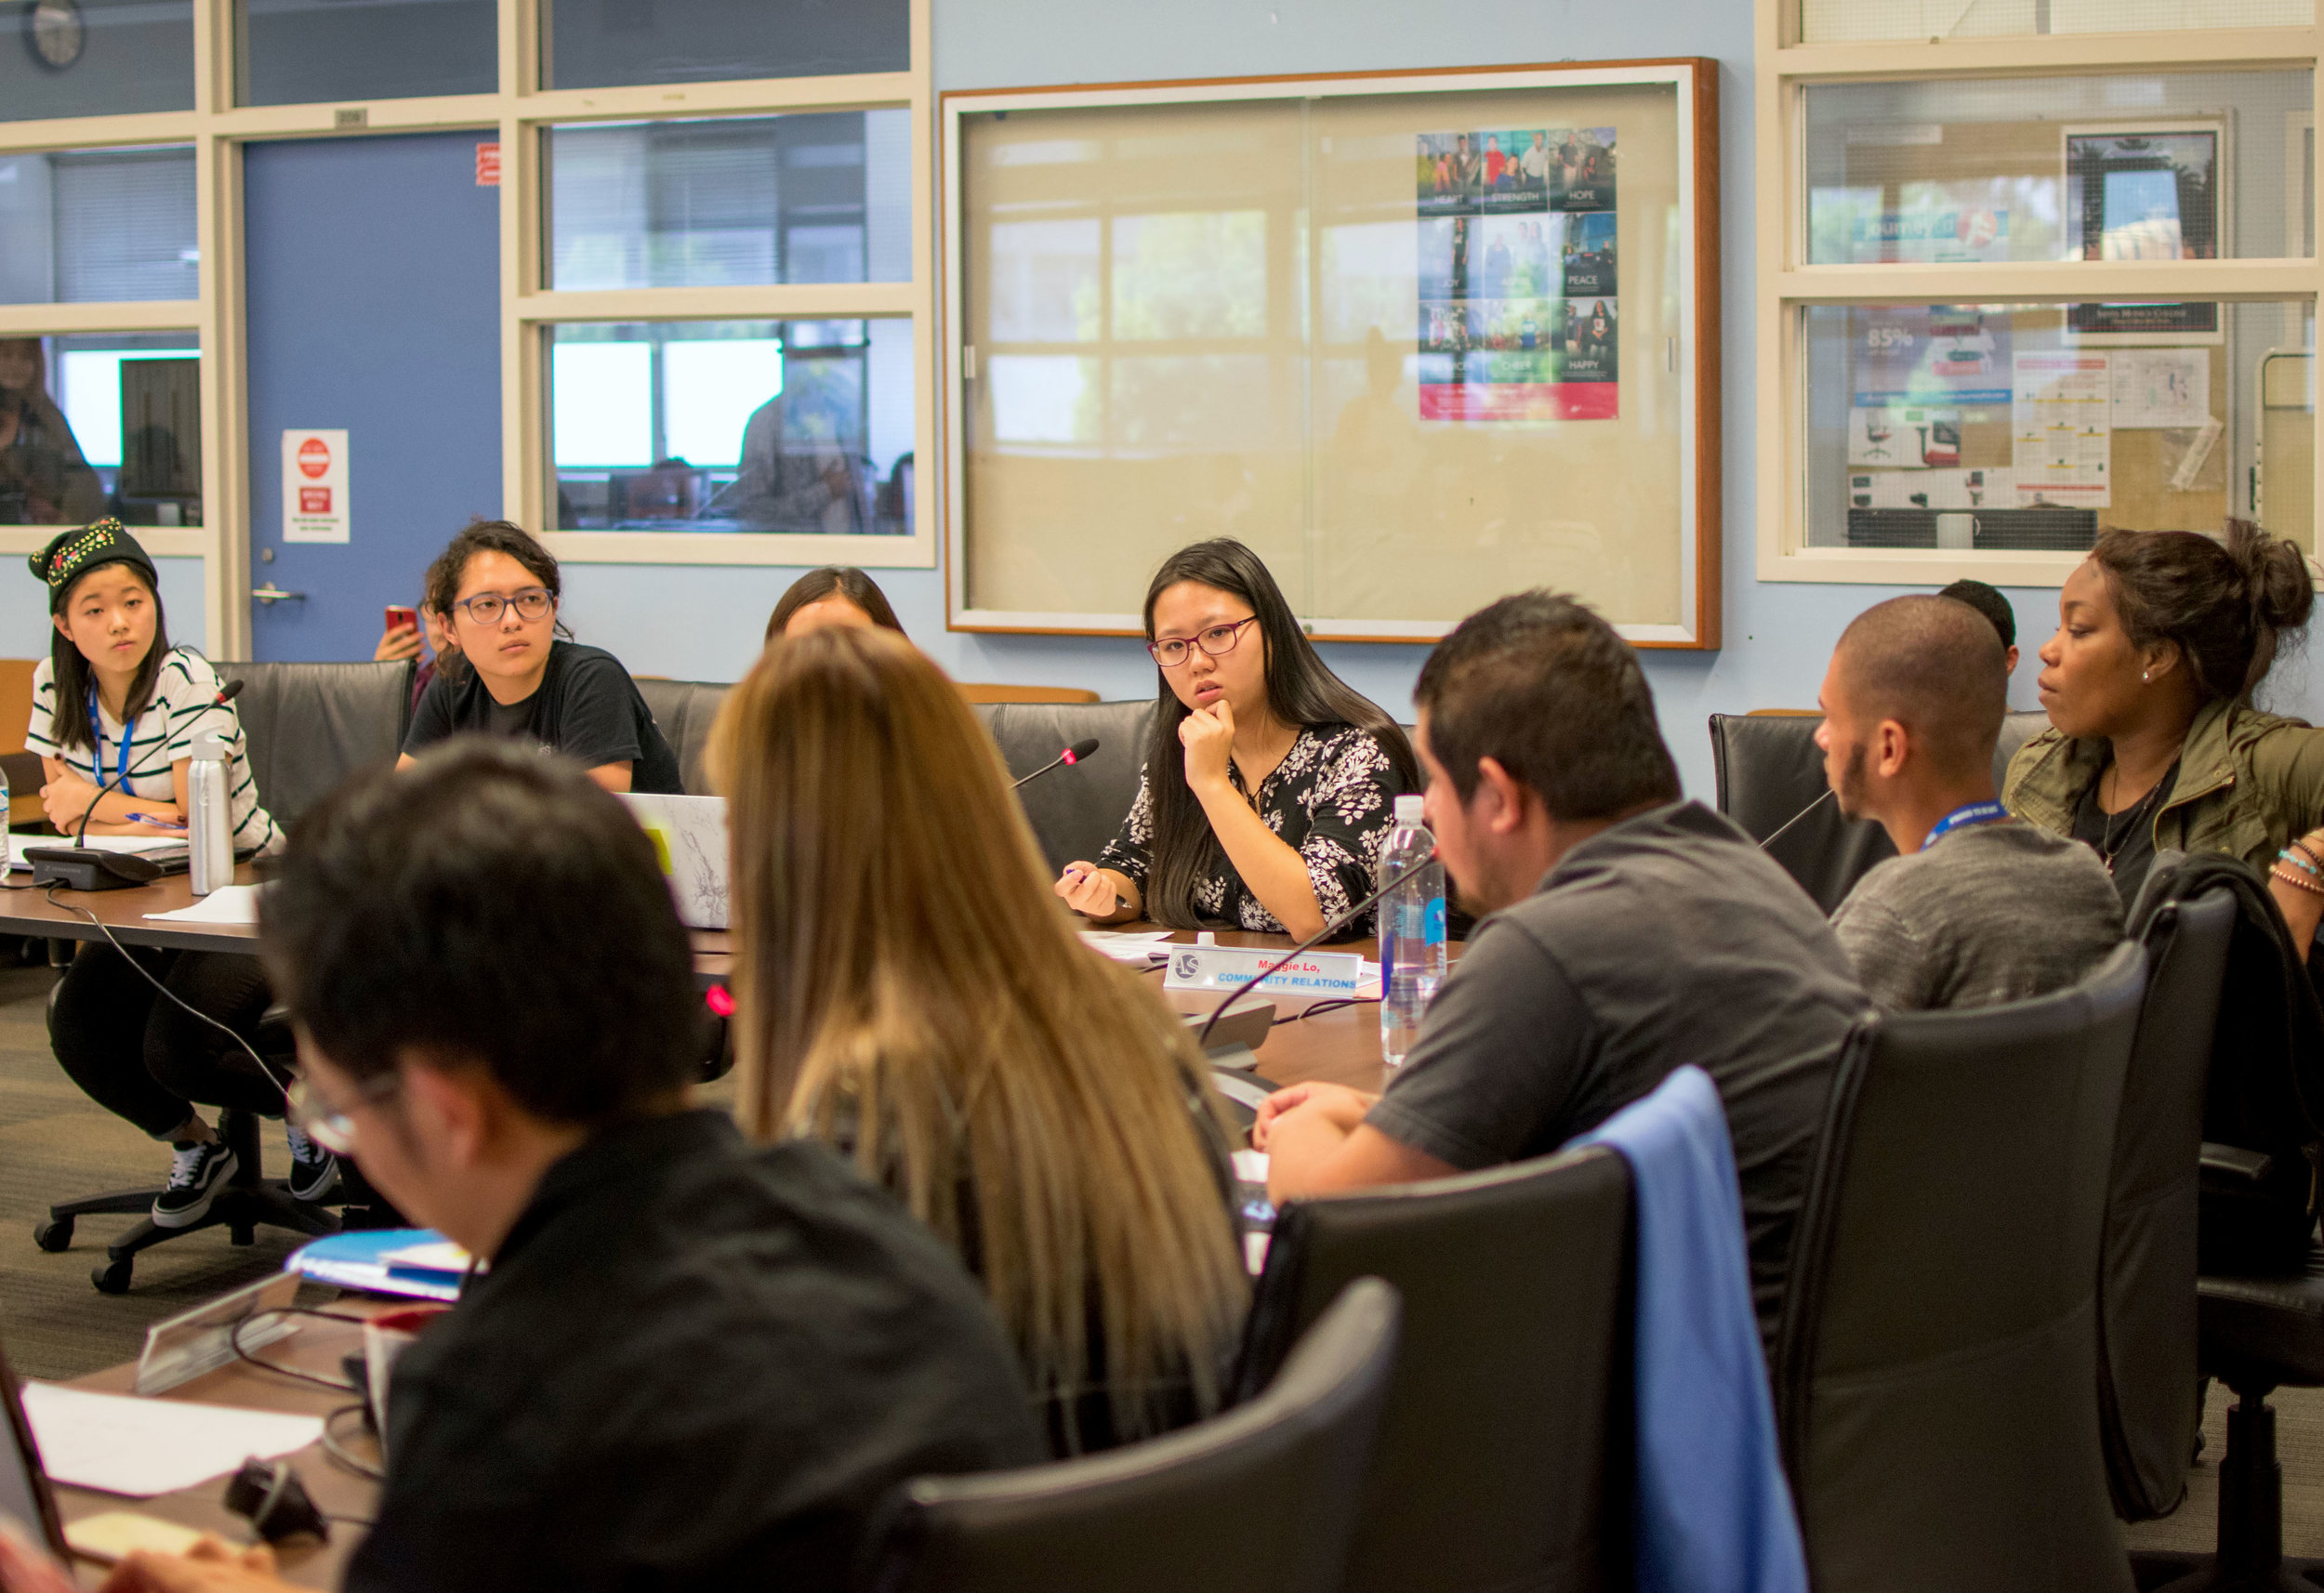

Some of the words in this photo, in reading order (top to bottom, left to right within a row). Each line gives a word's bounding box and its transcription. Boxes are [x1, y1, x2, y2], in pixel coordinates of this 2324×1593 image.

[1434, 193, 1463, 204] HEART
[1491, 192, 1539, 203] STRENGTH
[1568, 190, 1595, 200] HOPE
[1568, 275, 1599, 285] PEACE
[1868, 328, 1914, 349] 85%
[1568, 361, 1599, 370] HAPPY
[1302, 962, 1321, 973] Lo,
[1218, 973, 1287, 986] COMMNITY
[1290, 977, 1356, 989] RELATIONS
